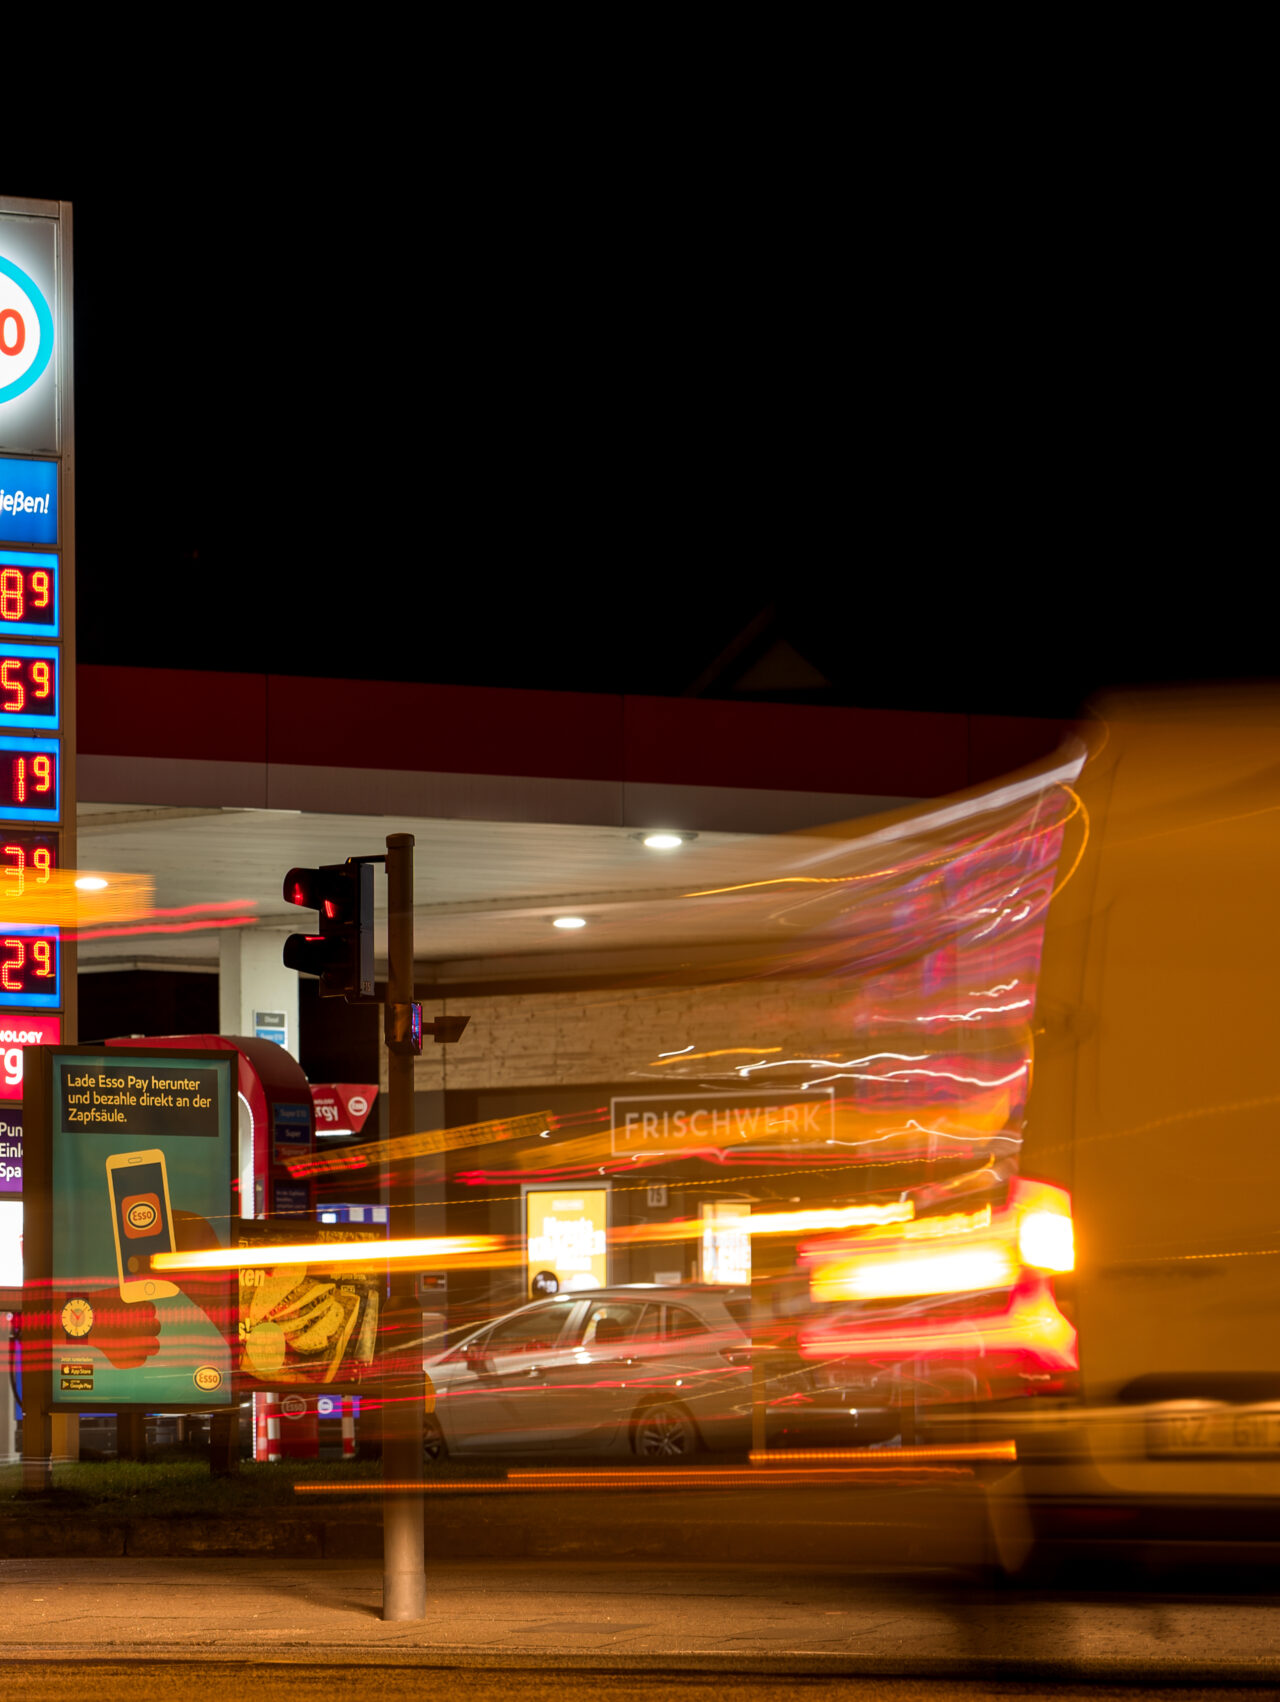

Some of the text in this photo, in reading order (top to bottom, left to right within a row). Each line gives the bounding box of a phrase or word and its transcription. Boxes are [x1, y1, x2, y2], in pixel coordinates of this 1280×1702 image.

[67, 1074, 200, 1092] Lade Esso Pay herunter
[68, 1091, 212, 1108] und bezahle direkt an der
[68, 1108, 127, 1125] Zapfsäule.
[625, 1105, 821, 1139] FRISCHWERK
[132, 1209, 153, 1221] Esso
[199, 1375, 217, 1384] Esso
